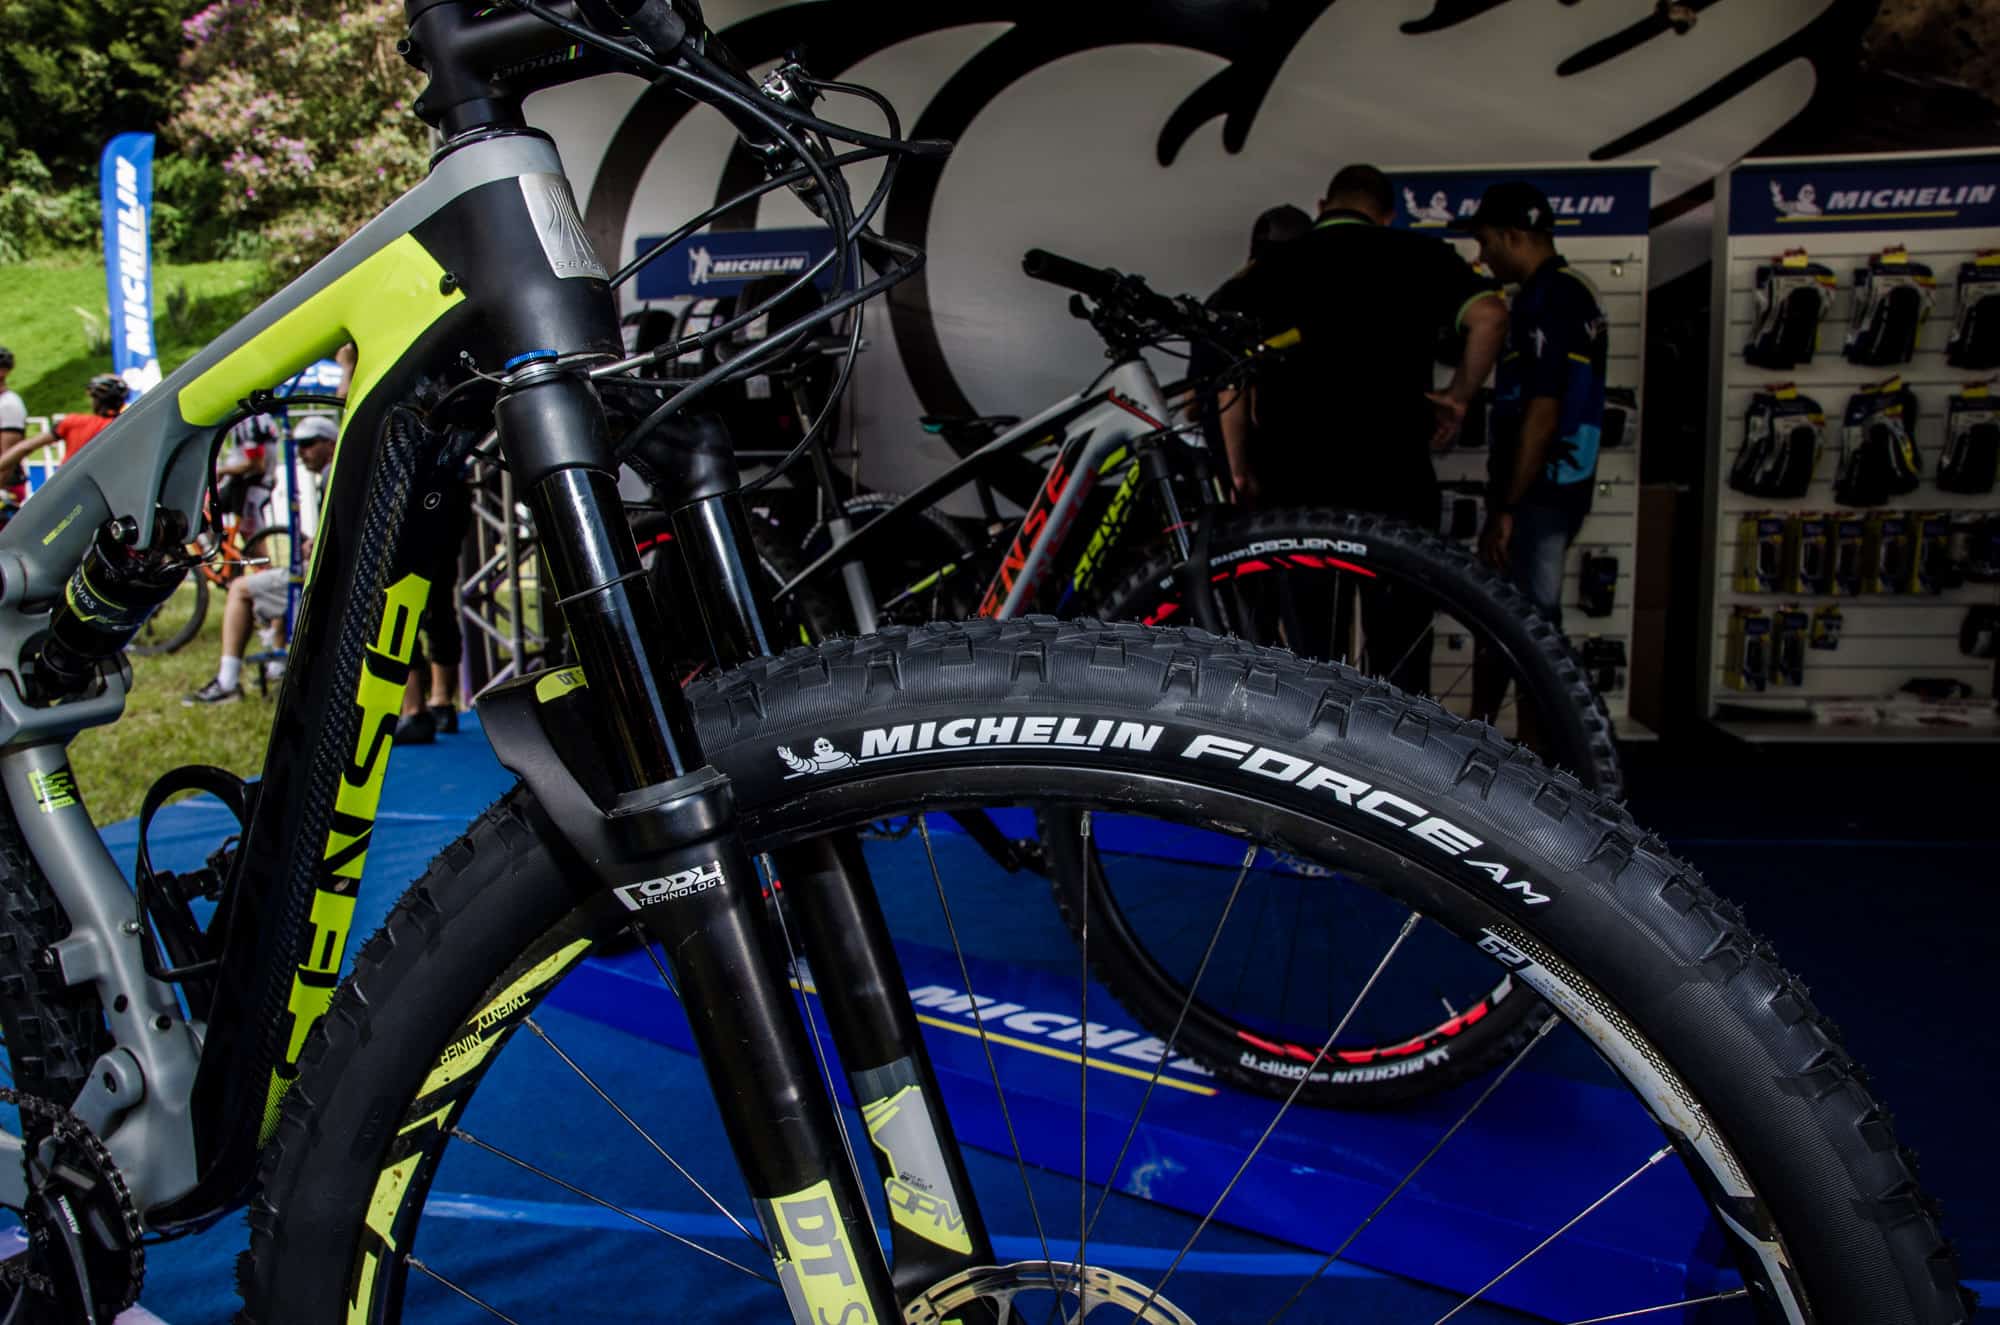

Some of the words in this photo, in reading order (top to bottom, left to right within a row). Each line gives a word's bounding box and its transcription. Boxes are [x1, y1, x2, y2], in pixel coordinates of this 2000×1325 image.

[1458, 195, 1616, 217] MELIN
[1825, 184, 1997, 210] MICHELIN
[116, 156, 150, 357] MICHELIN
[713, 257, 805, 273] MICHELIN
[860, 716, 1165, 757] MICHELIN
[1180, 734, 1484, 856] FORCE
[1463, 858, 1552, 905] AM
[640, 876, 726, 906] TECHNOLOGY
[478, 993, 531, 1032] TWENTY
[440, 1031, 481, 1065] NINER
[909, 985, 1215, 1077] MICHE
[1331, 1056, 1425, 1084] MICHELIN
[780, 1196, 857, 1288] DT
